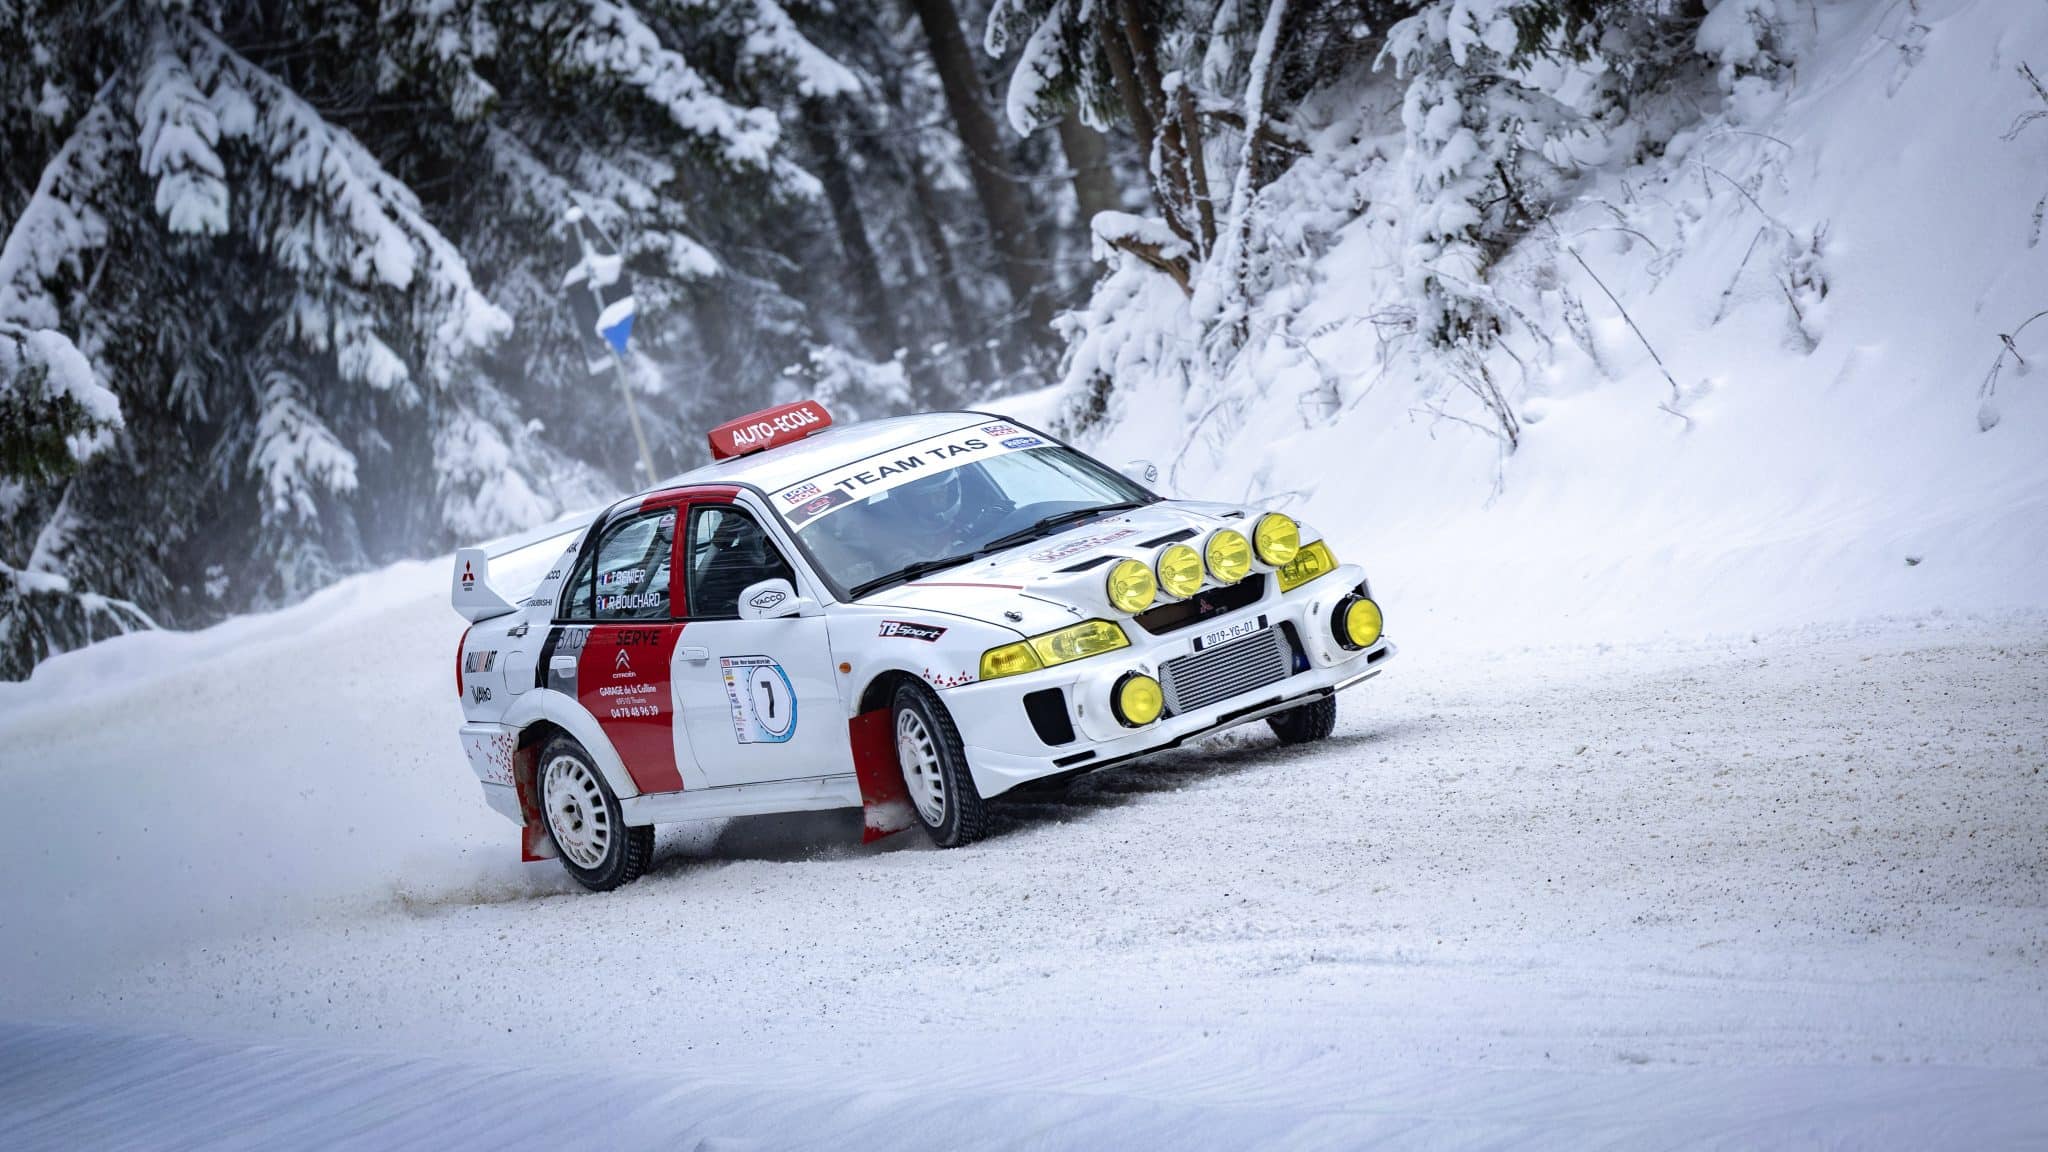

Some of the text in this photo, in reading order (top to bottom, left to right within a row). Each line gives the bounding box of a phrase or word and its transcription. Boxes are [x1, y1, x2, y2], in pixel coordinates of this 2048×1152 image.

[732, 407, 819, 447] AUTO-ECOLE
[834, 456, 926, 490] TEAM
[925, 438, 989, 460] TAS
[754, 594, 782, 605] YACCO
[1207, 621, 1254, 645] 3019-YG-01
[599, 686, 624, 697] GARAGE
[760, 681, 775, 718] 7
[610, 708, 621, 719] 04
[620, 708, 631, 718] 78
[640, 706, 650, 716] 96
[649, 705, 659, 716] 39
